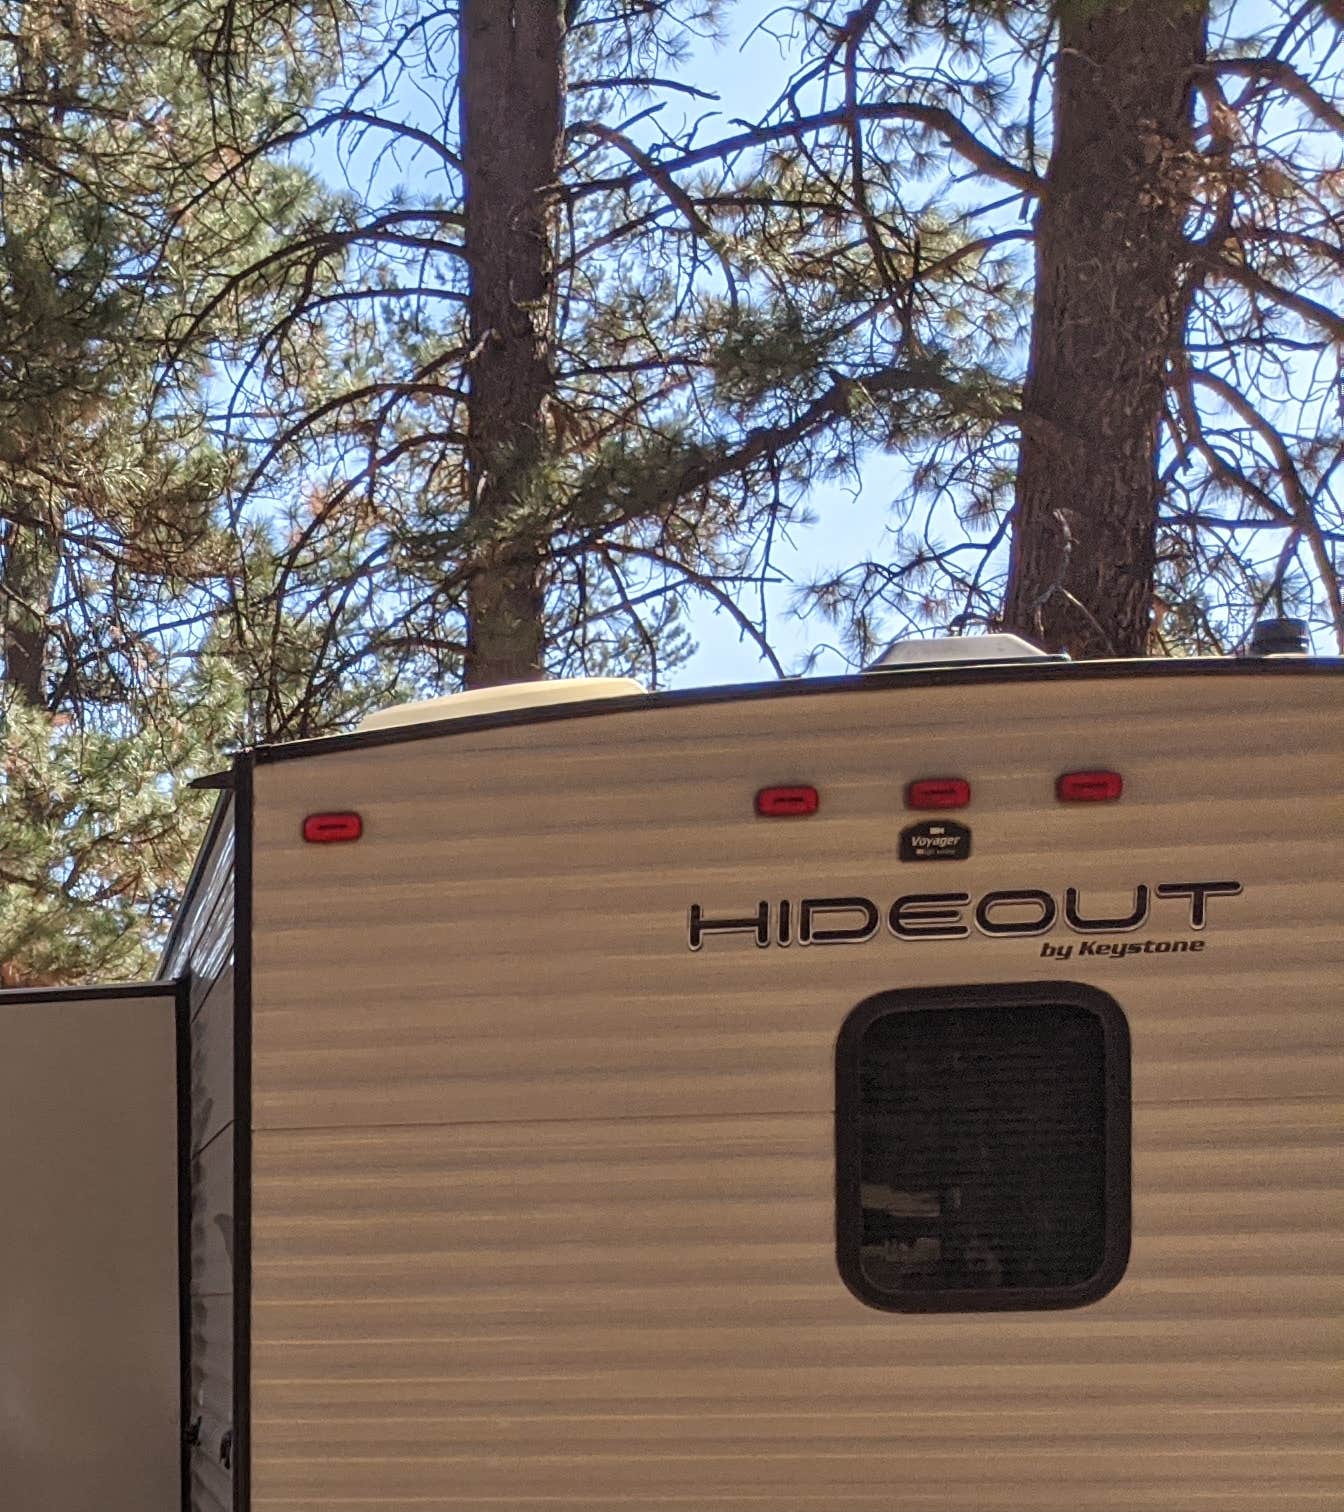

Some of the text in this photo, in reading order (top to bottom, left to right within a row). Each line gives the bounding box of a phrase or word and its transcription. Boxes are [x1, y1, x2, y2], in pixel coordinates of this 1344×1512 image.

[912, 836, 960, 848] Voyager
[688, 881, 1243, 952] HIDEOUT
[1040, 939, 1205, 960] by Keystone
